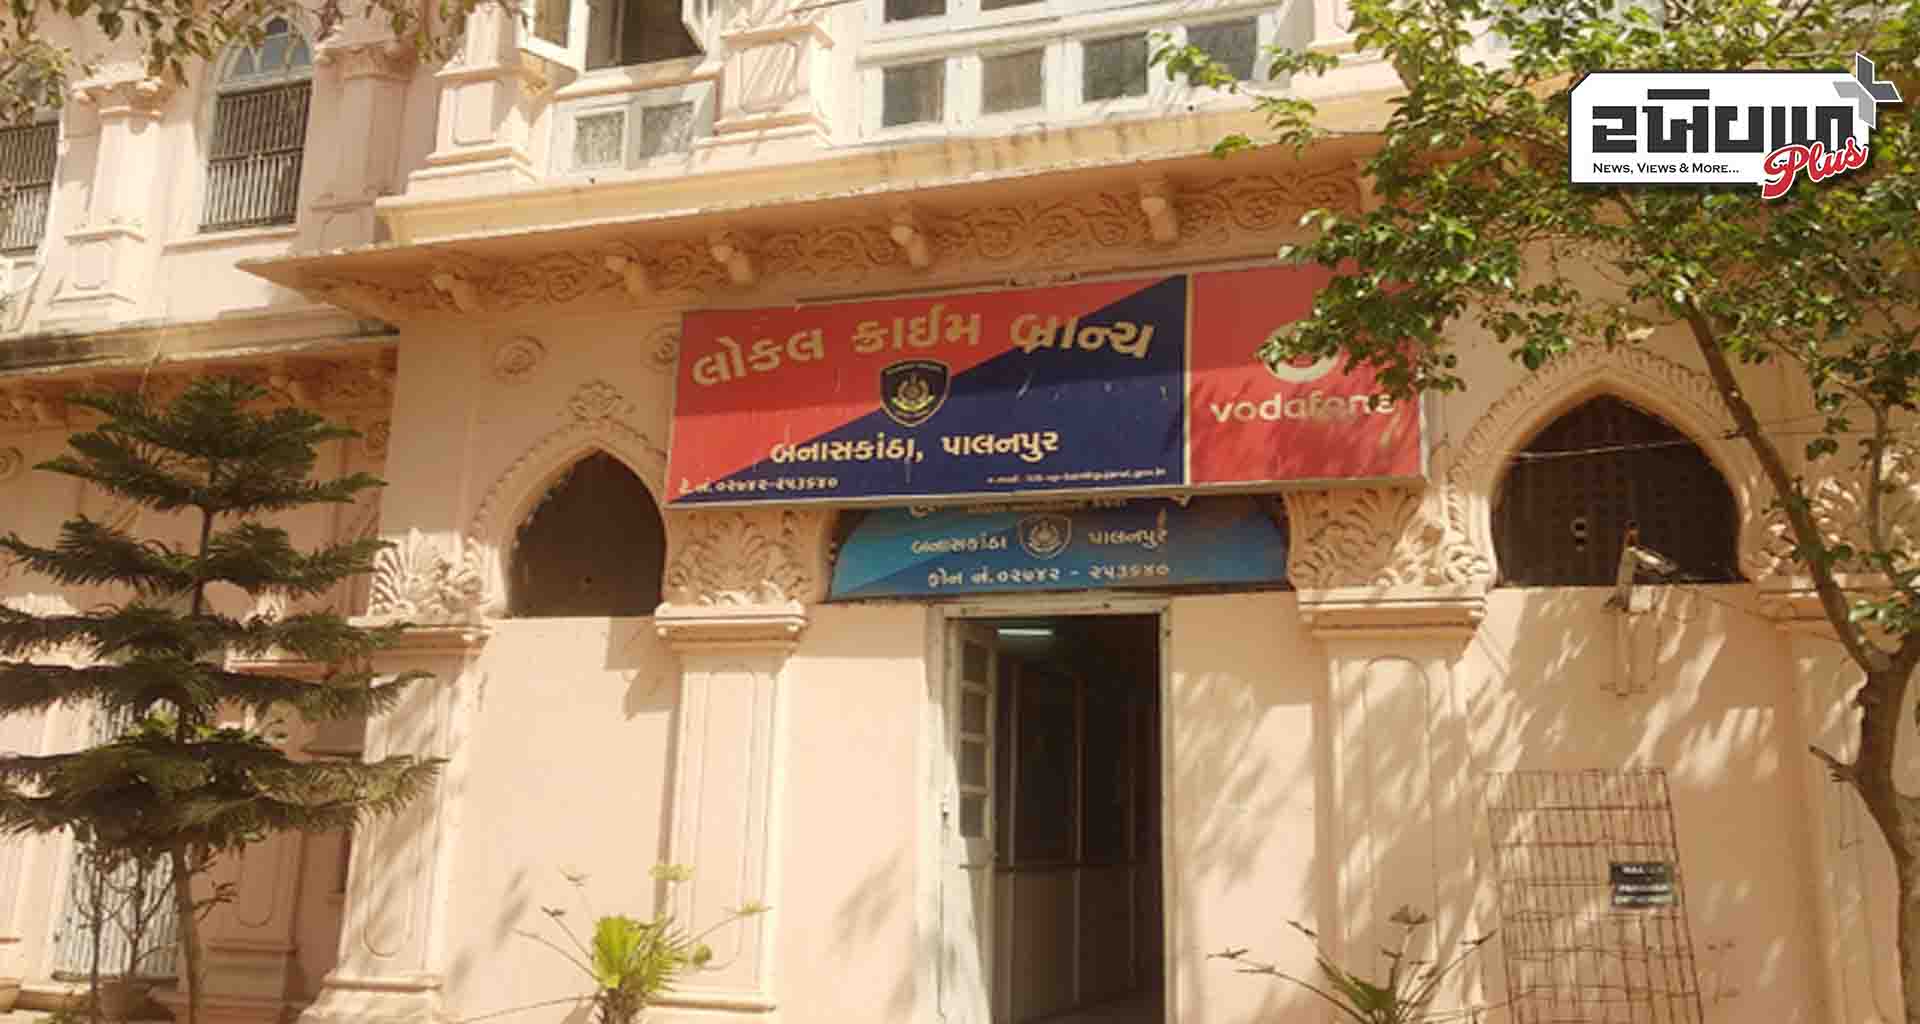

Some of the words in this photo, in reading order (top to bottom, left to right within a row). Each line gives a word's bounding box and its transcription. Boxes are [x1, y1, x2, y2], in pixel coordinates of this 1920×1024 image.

[692, 327, 825, 386] લોકલ
[851, 303, 982, 353] ક્રાઈમ
[1010, 313, 1155, 360] બ્રાન્ચ
[769, 431, 925, 464] બનાસકાંઠા,
[941, 430, 1060, 464] પાલનપુર
[911, 531, 1008, 555] બનાસકાંઠા
[1087, 526, 1169, 550] પાલનપુર
[927, 566, 963, 588] ફોન
